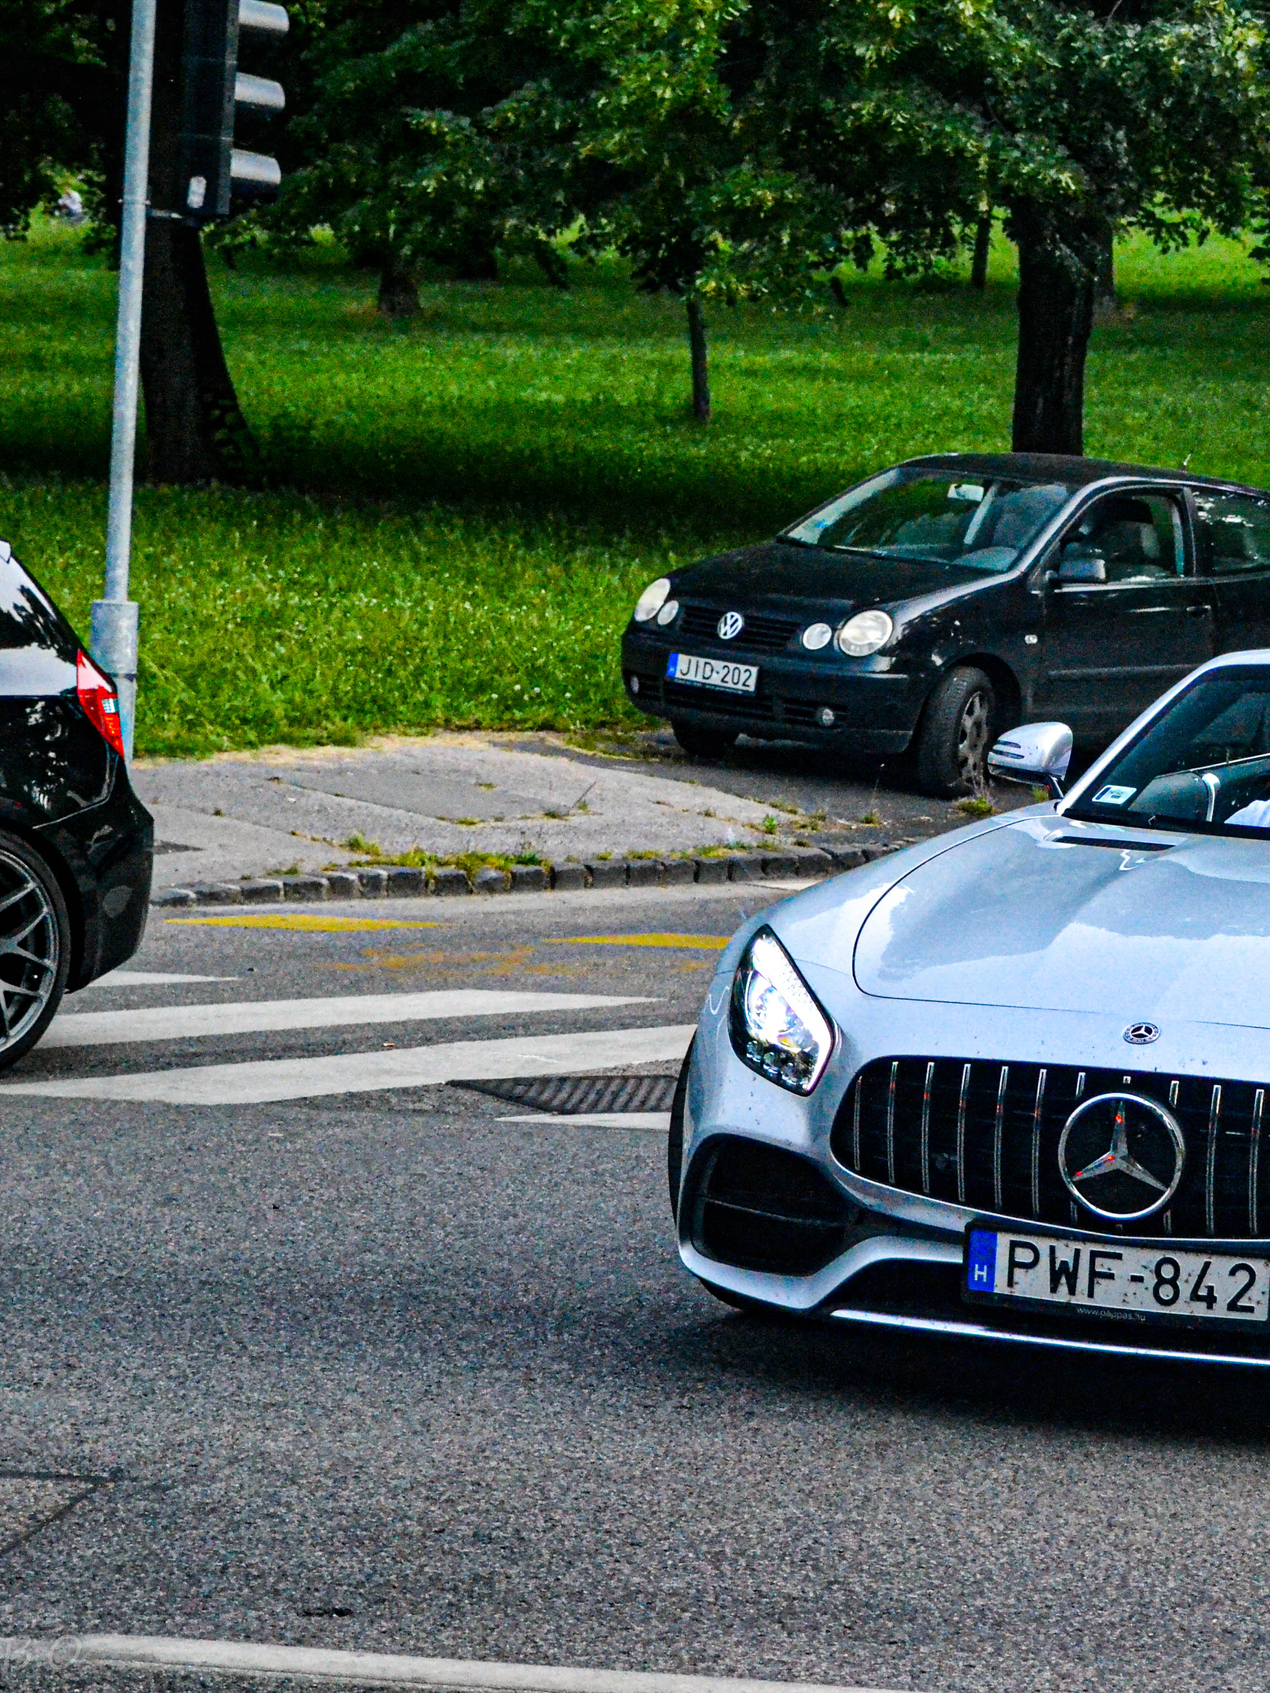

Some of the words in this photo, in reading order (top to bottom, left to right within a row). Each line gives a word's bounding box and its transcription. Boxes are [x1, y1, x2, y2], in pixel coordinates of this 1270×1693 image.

[680, 659, 752, 688] JID-202
[974, 1263, 987, 1282] H
[1007, 1239, 1256, 1313] PWF-842
[1077, 1307, 1146, 1321] www.pappas.hu
